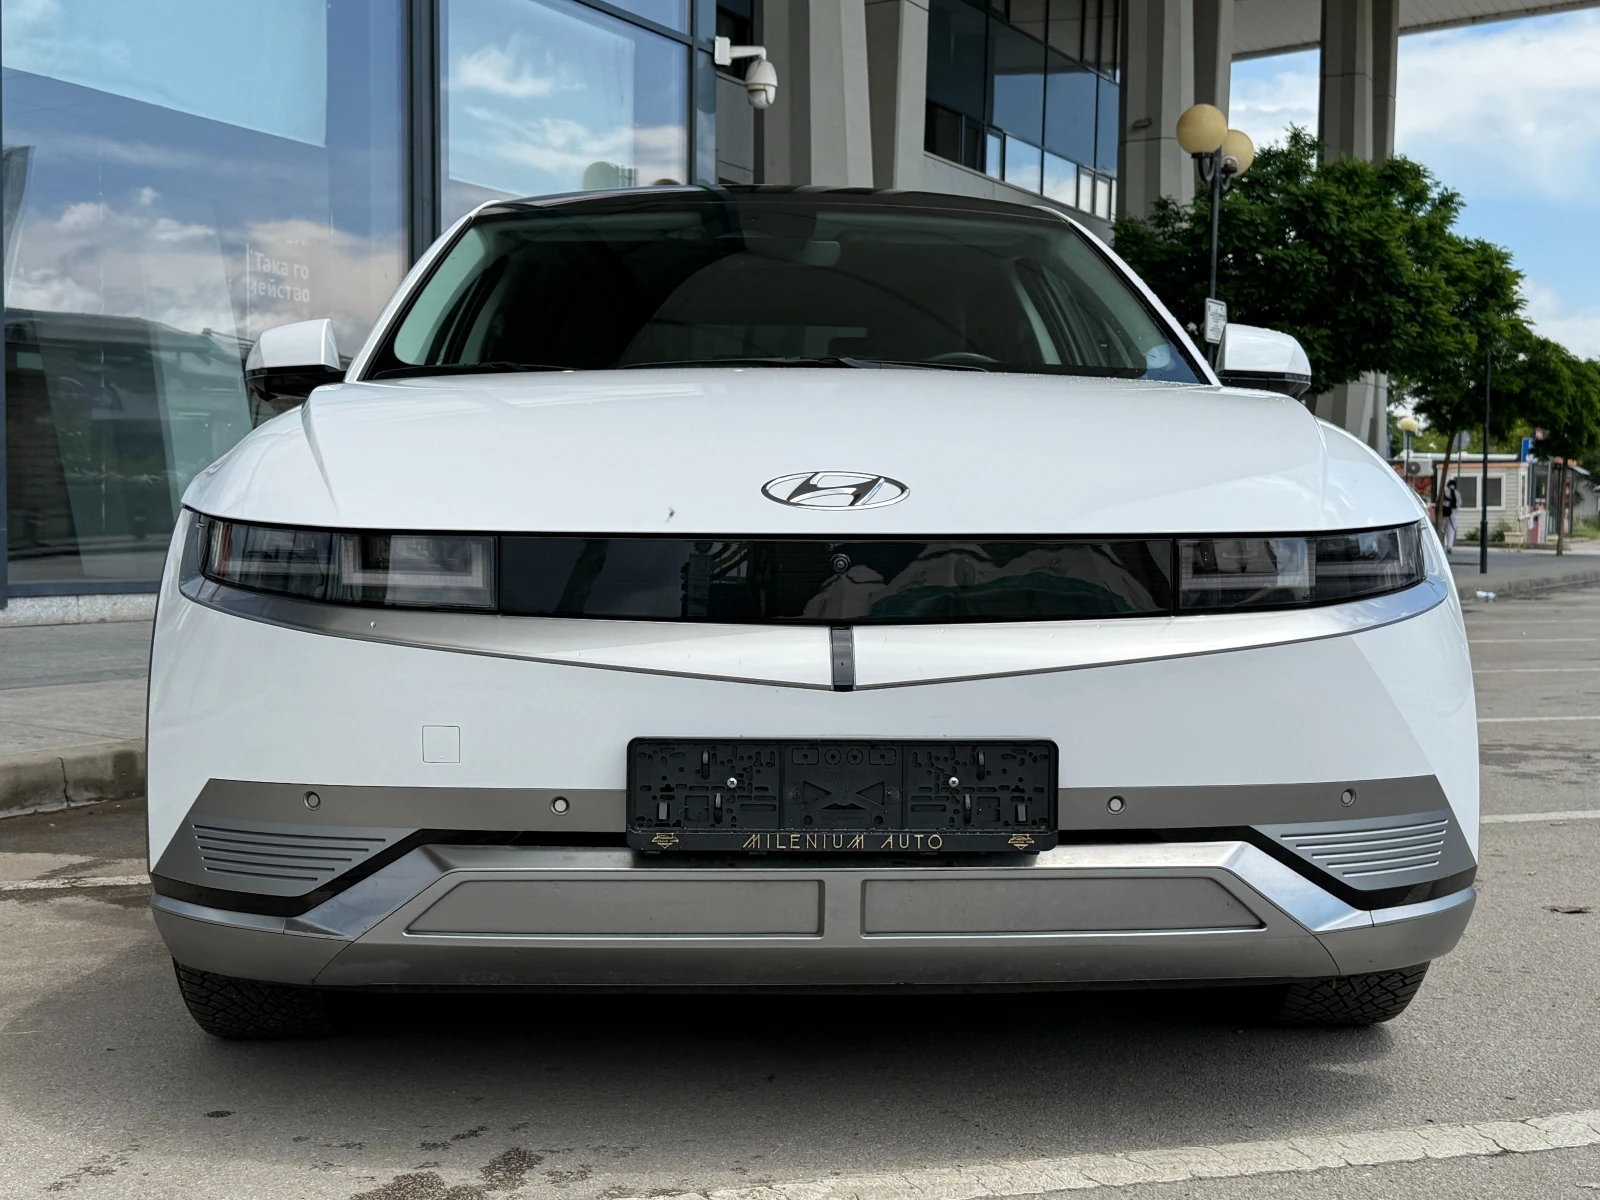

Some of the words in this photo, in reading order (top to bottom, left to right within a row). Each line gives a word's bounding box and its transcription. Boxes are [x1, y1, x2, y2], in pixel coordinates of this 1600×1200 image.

[293, 263, 309, 280] го
[742, 833, 864, 849] MILENIUM
[880, 834, 943, 850] AUTO
